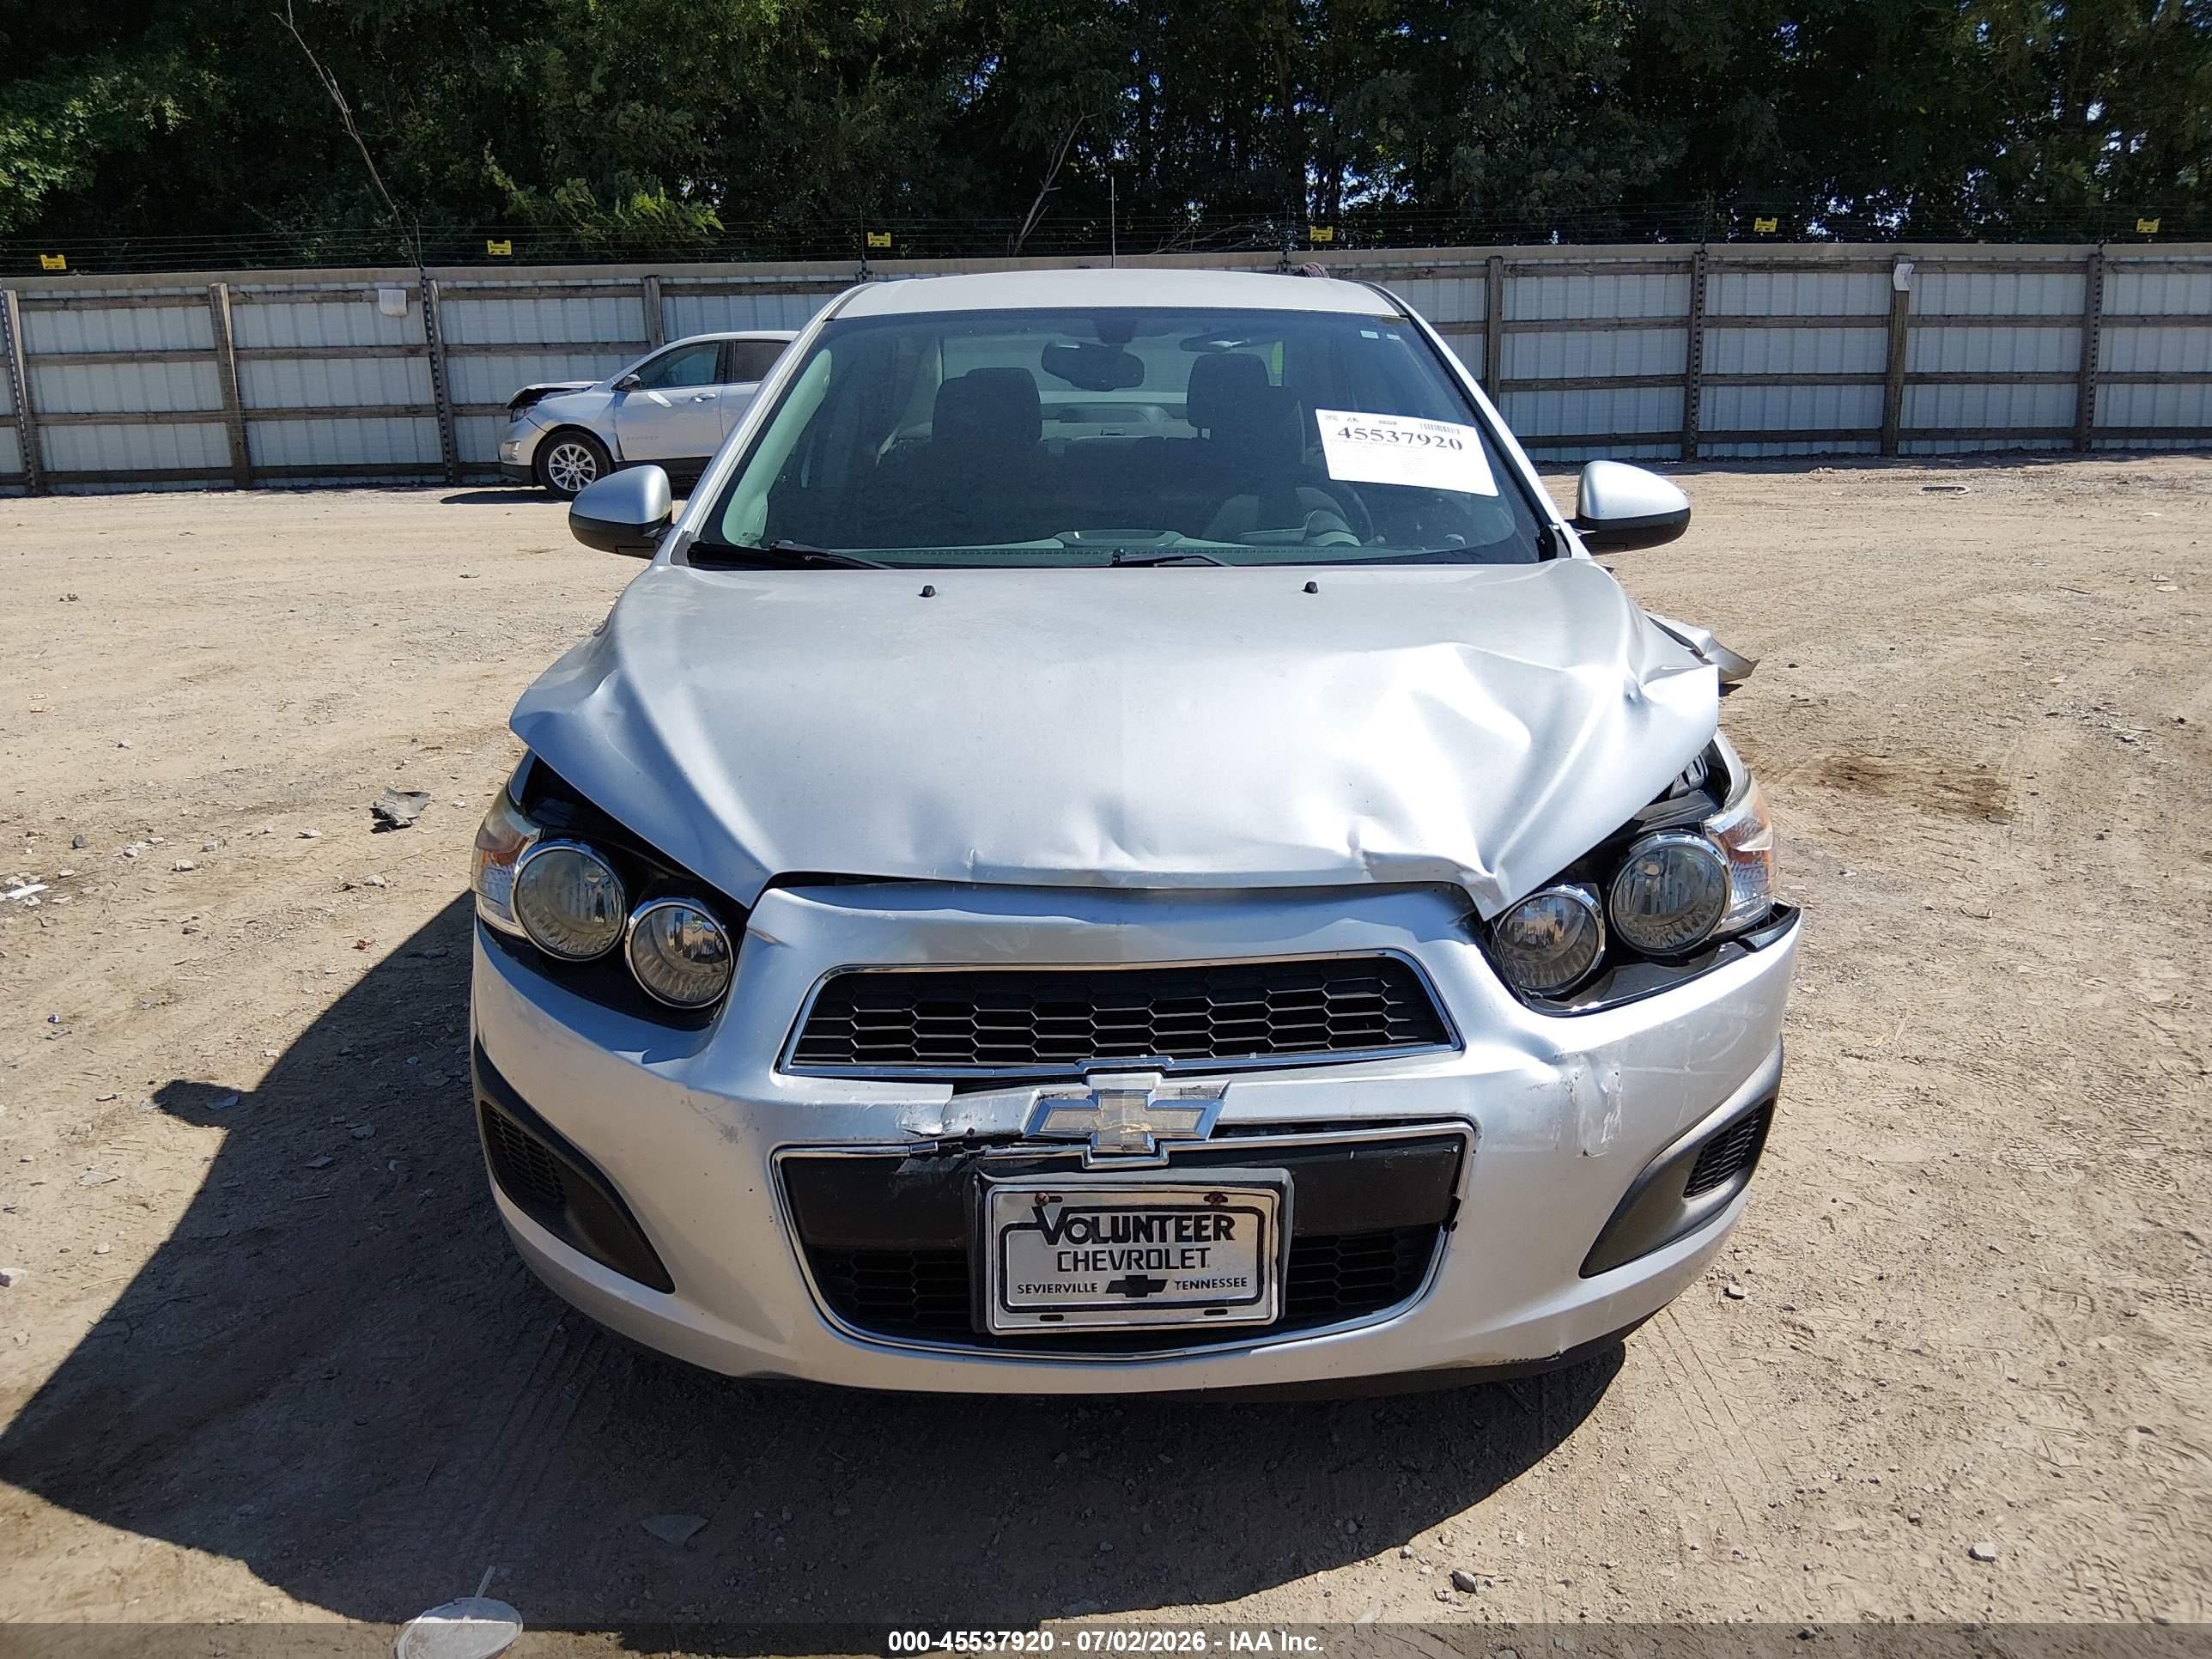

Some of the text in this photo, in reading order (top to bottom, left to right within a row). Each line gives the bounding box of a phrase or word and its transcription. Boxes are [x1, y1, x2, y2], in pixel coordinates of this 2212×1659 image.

[1337, 426, 1463, 451] 45537920
[1031, 1205, 1235, 1245] VOLUNTEER
[1057, 1248, 1211, 1272] CHEVROLET
[1018, 1278, 1247, 1294] SEVIERVILLE TENNESSEE
